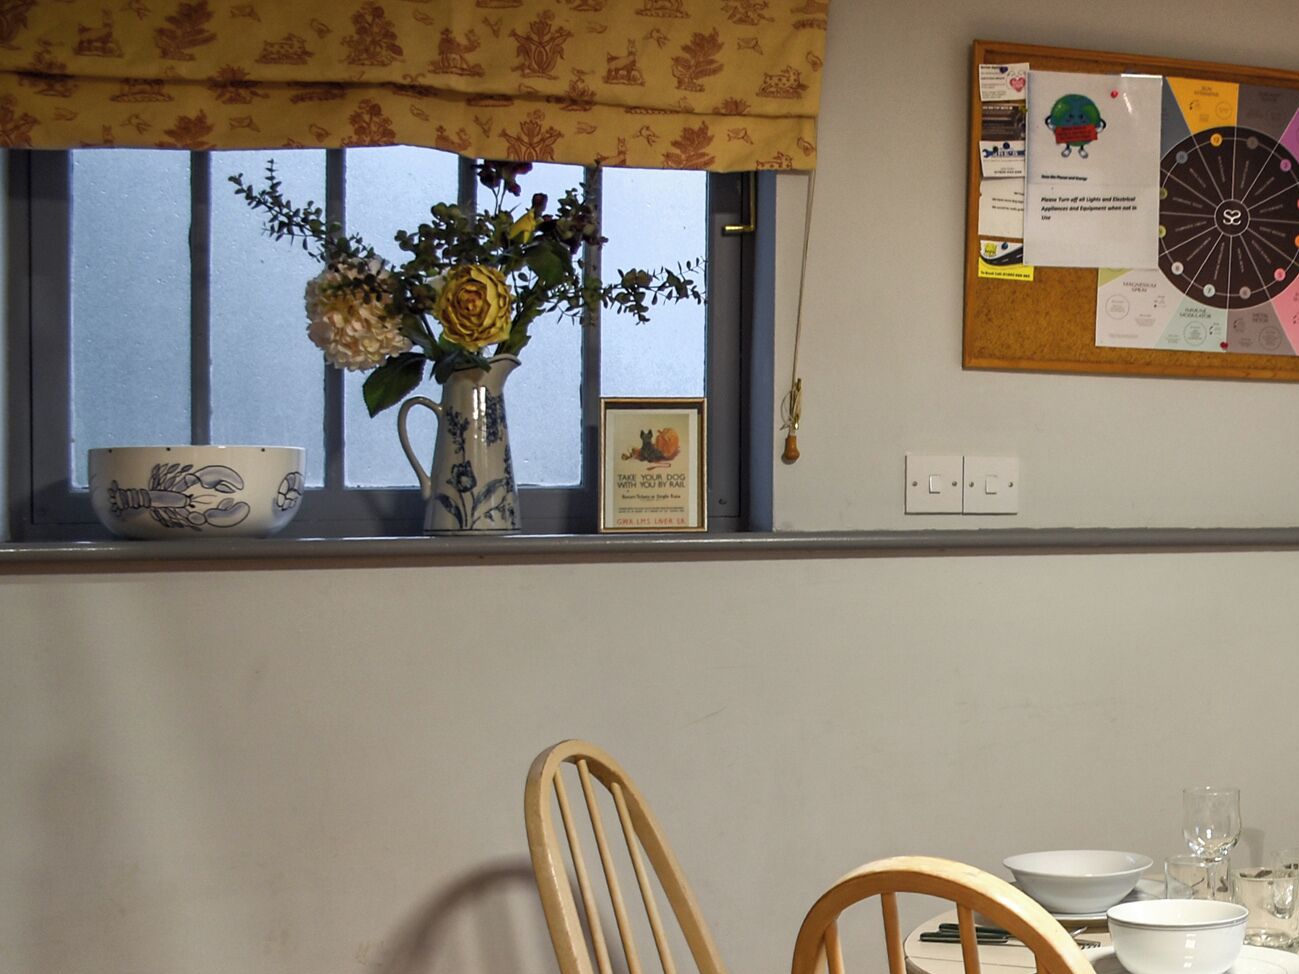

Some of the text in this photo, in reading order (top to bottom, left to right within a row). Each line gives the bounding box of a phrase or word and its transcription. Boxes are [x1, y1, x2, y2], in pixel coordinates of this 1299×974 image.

[617, 473, 636, 481] TAKE
[641, 473, 662, 481] YOUR
[617, 481, 637, 489] WITH
[669, 480, 686, 488] RAIL
